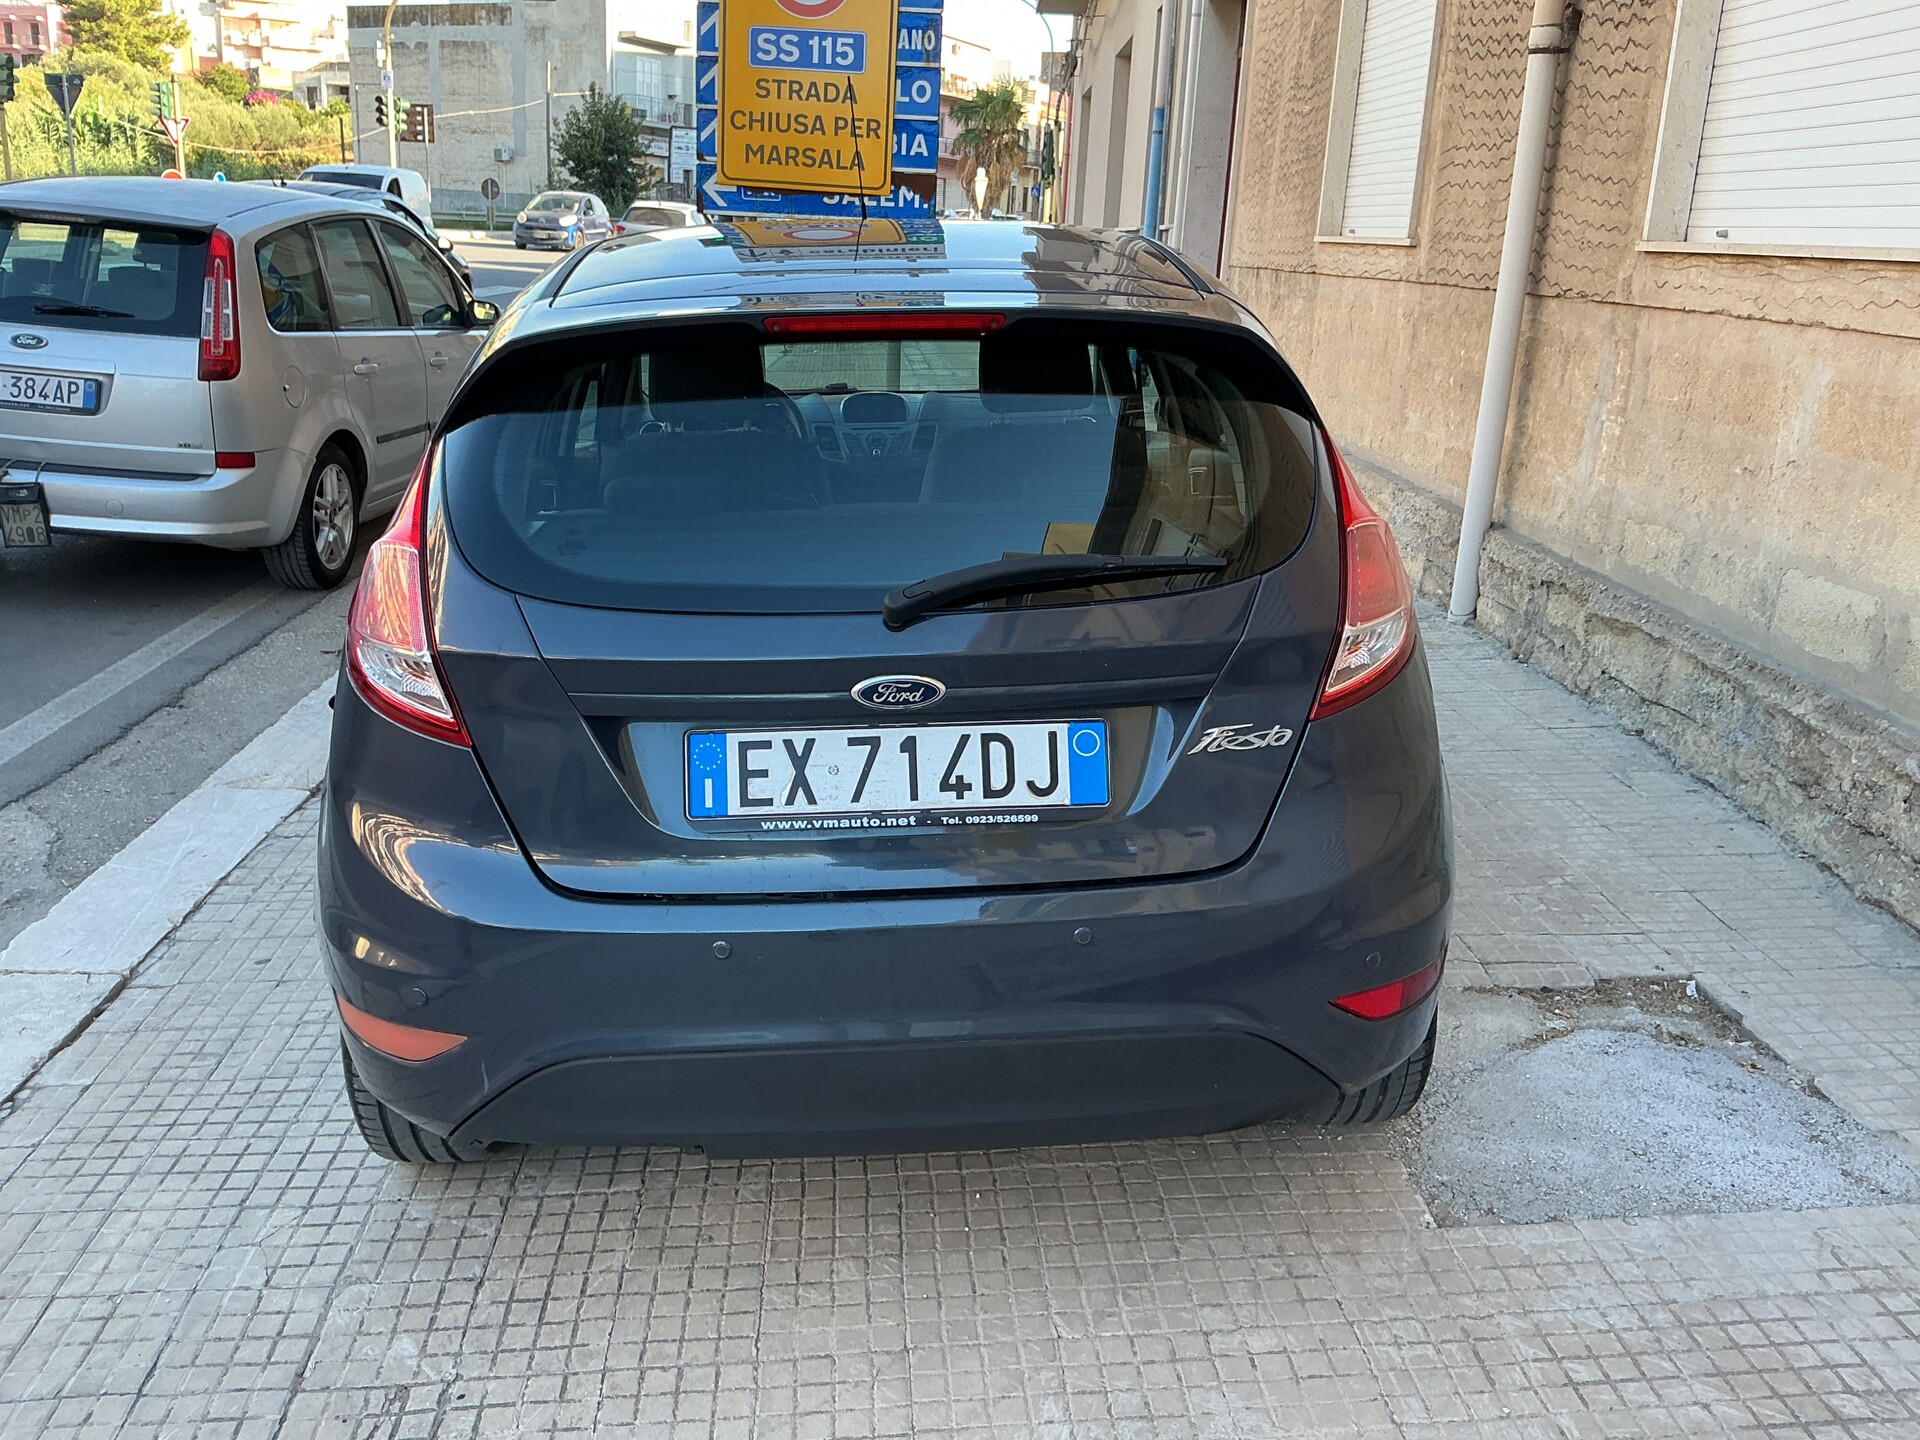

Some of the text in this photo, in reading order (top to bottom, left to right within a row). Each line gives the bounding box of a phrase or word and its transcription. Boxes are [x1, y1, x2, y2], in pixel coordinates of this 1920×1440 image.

[756, 32, 855, 66] SS 115
[755, 77, 859, 105] STRADA
[730, 109, 882, 139] CHIUSA PER
[745, 143, 866, 171] MARSALA
[873, 682, 925, 702] Ford
[1187, 723, 1293, 755] Fiesta
[761, 815, 917, 831] www.vmauto.net
[940, 815, 963, 825] Tel.
[965, 813, 1039, 825] 0923/526599
